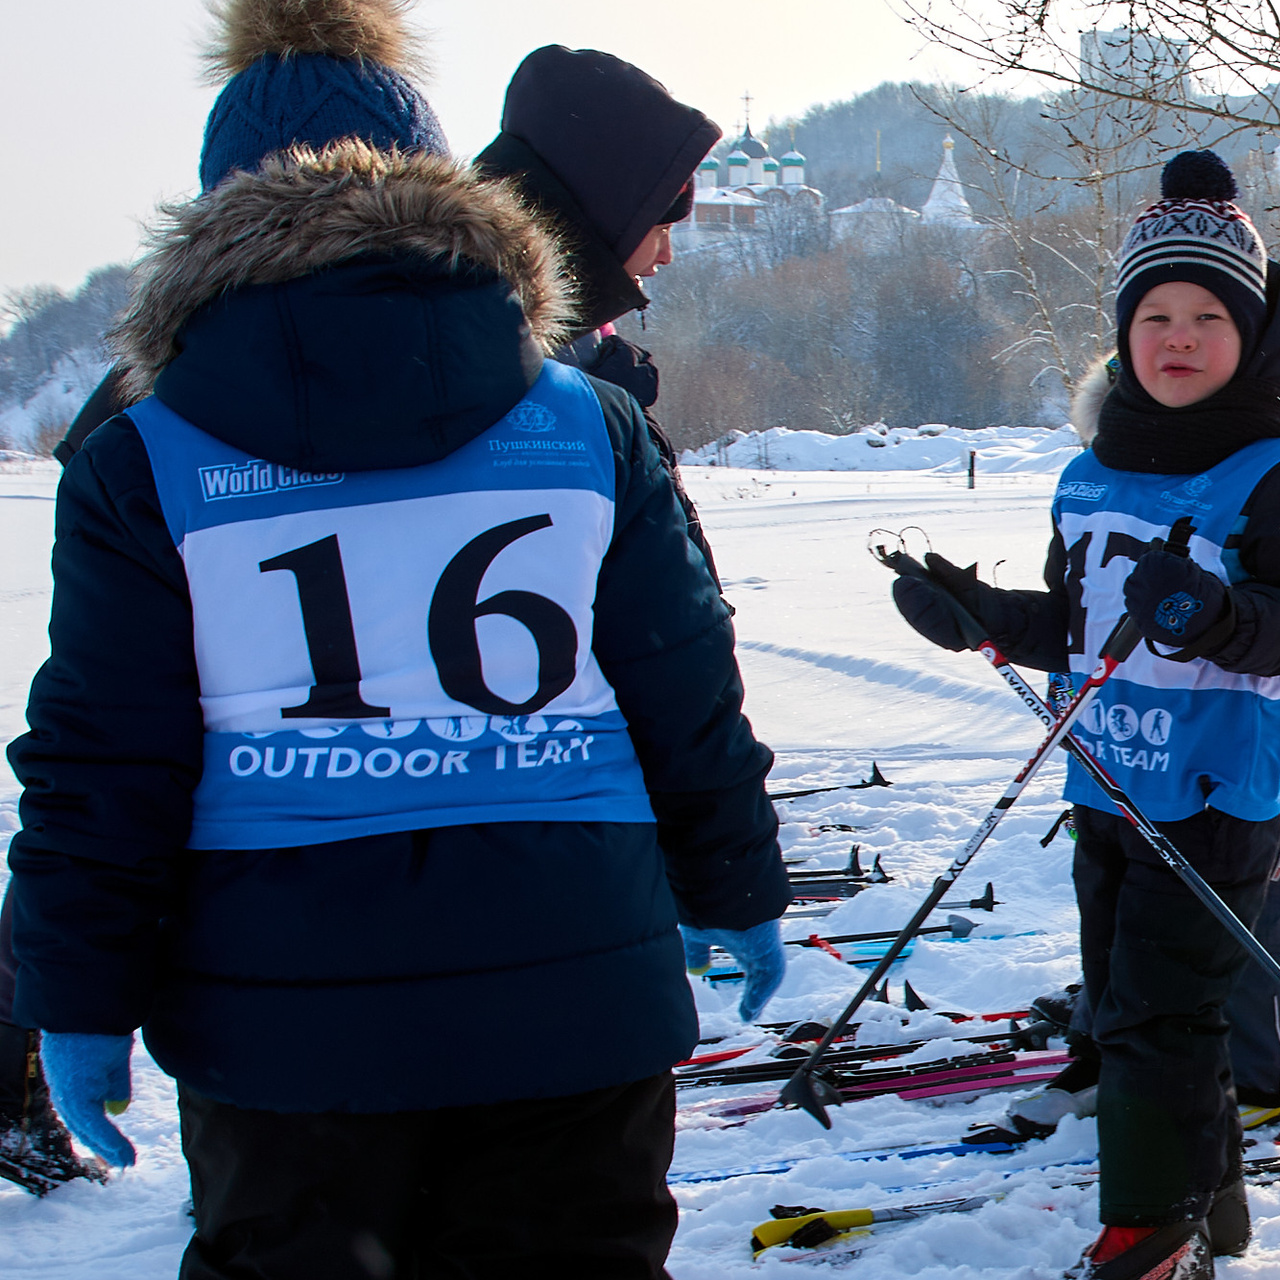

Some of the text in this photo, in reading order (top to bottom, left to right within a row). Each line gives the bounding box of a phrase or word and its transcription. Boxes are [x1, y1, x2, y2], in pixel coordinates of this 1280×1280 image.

[488, 440, 586, 453] Пушкинский
[204, 464, 273, 497] World
[259, 513, 578, 719] 16
[229, 744, 470, 779] OUTDOOR
[1110, 744, 1170, 772] TEAM
